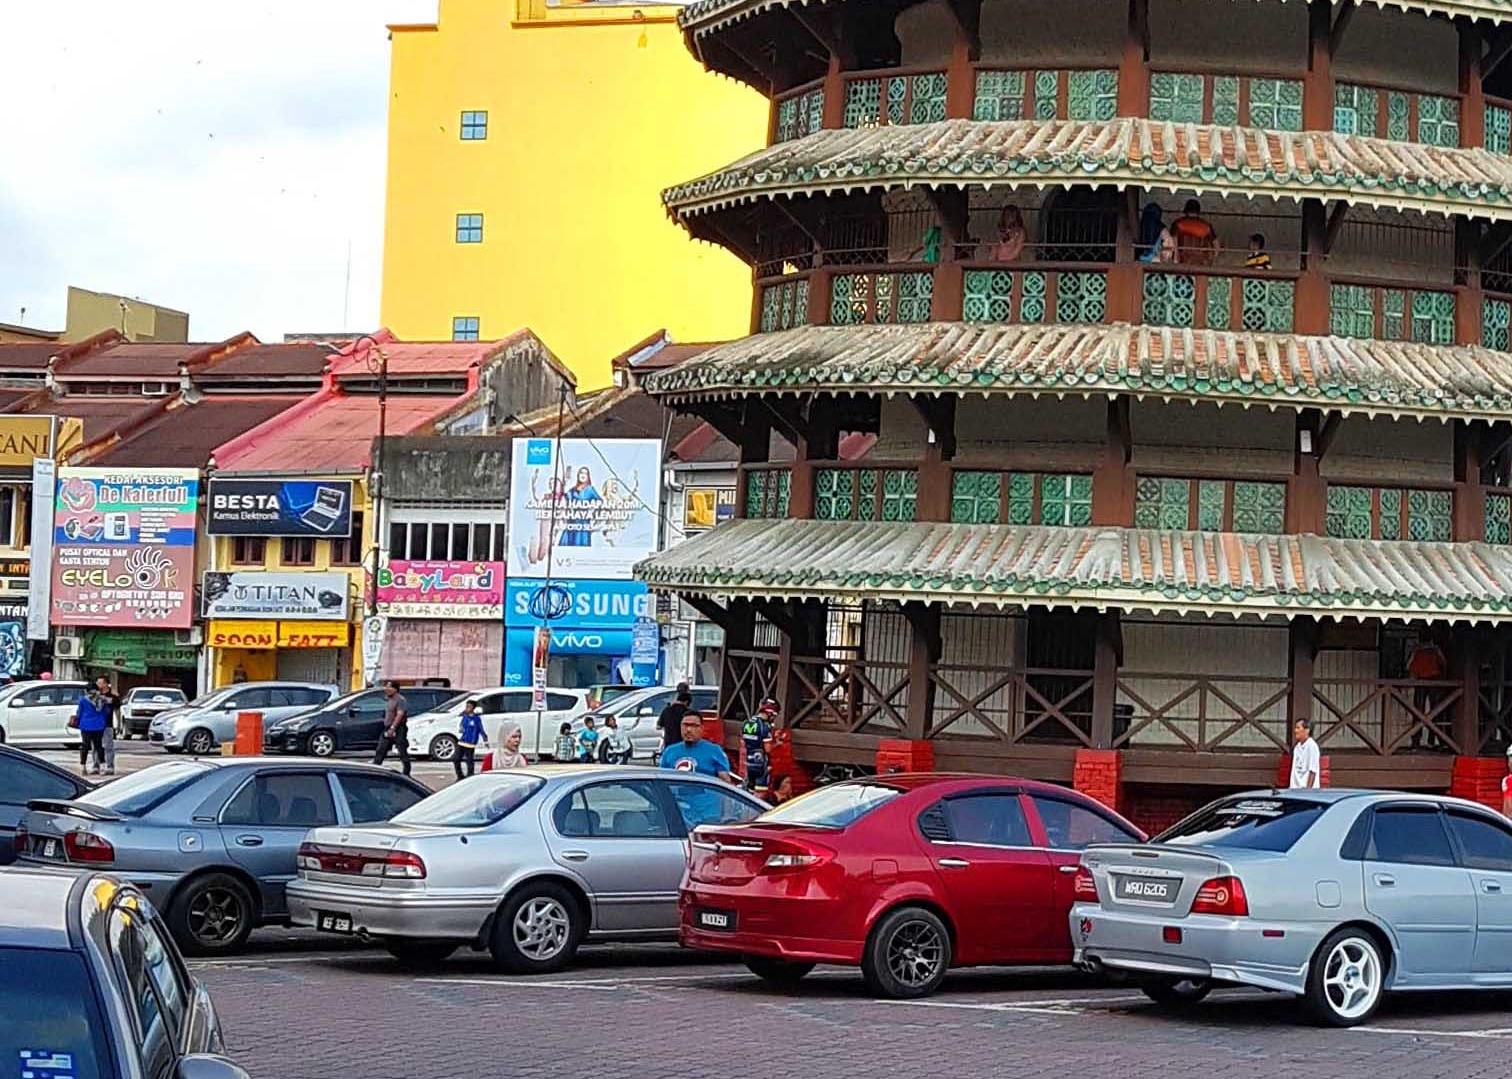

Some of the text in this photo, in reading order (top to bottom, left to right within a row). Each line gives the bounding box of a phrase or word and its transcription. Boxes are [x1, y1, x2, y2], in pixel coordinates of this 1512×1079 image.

[0, 433, 48, 454] ANI
[100, 486, 119, 503] De
[214, 495, 280, 509] BESTA
[213, 511, 239, 520] Kamus
[251, 585, 316, 600] TITAN
[1144, 883, 1168, 897] 6205
